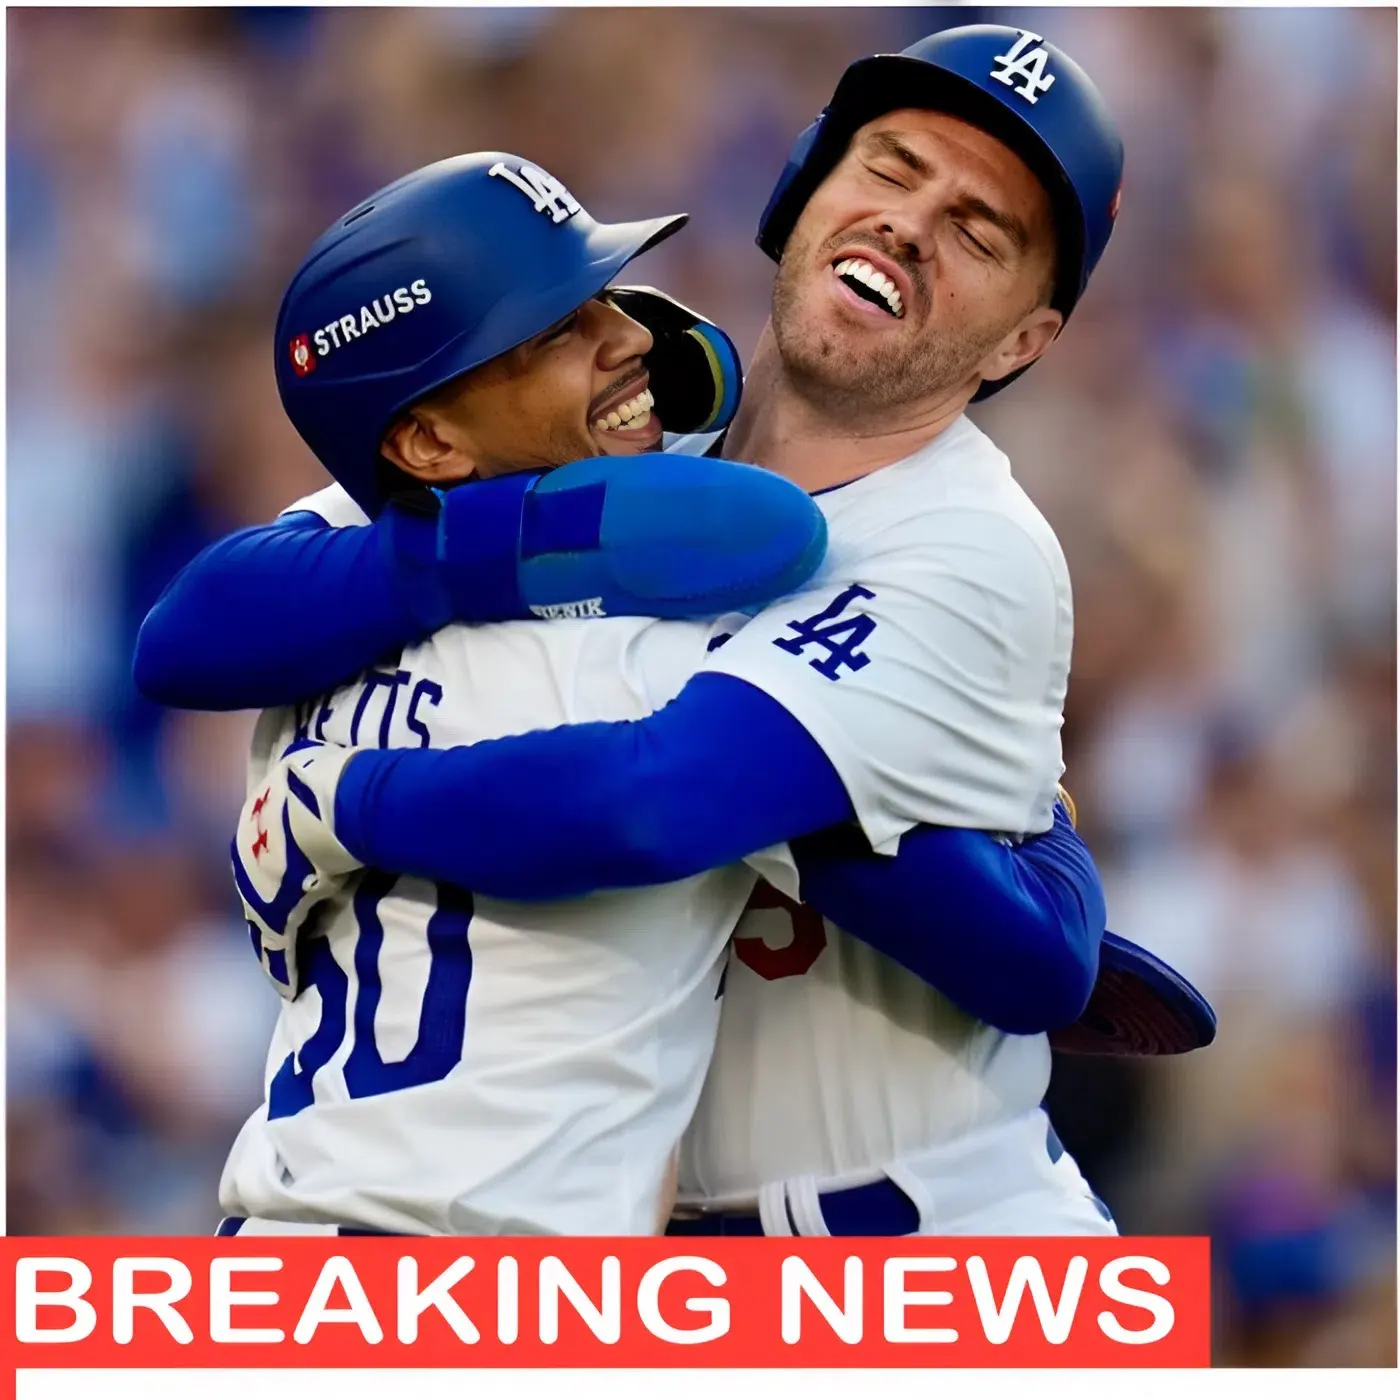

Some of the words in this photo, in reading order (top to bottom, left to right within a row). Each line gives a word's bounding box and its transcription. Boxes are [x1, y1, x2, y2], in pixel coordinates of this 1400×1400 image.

[990, 31, 1055, 104] LA
[488, 163, 580, 223] LA
[314, 279, 432, 356] STRAUSS
[772, 583, 877, 681] LA
[293, 669, 443, 750] ETTS
